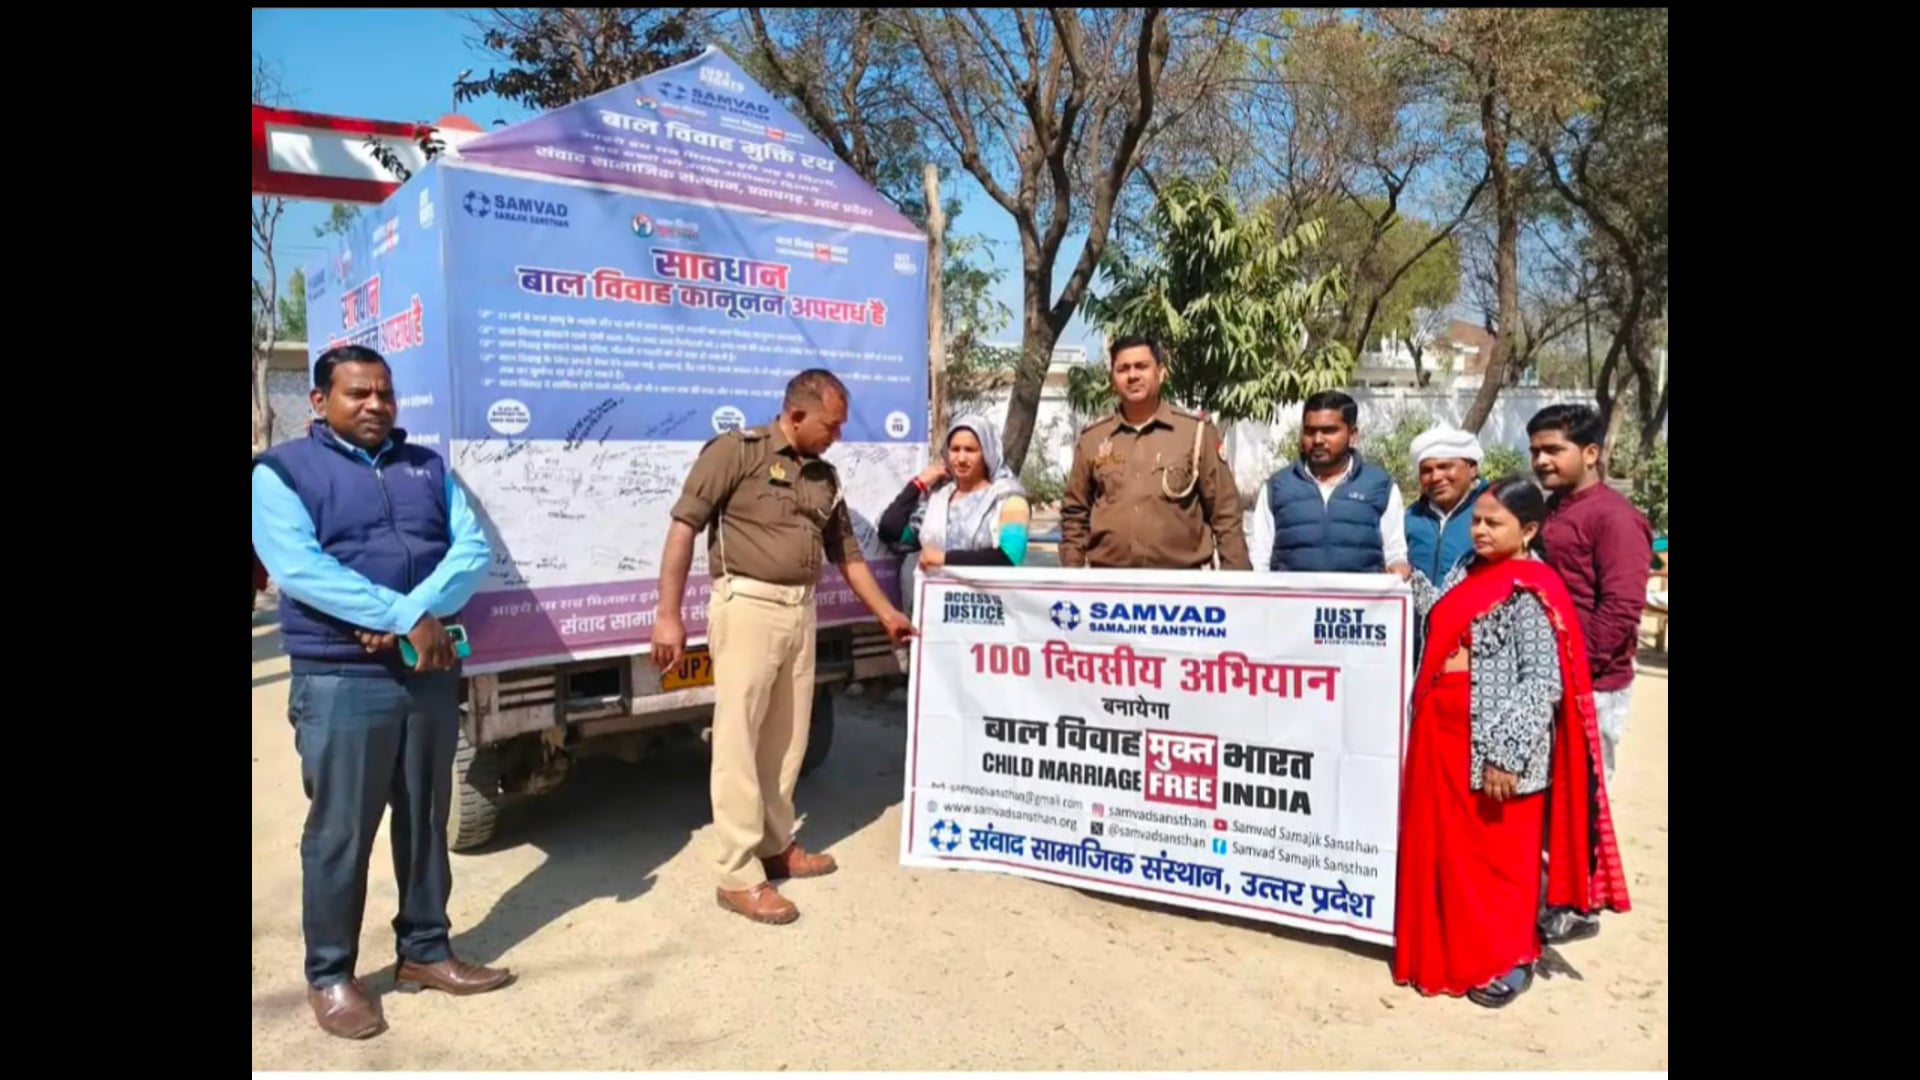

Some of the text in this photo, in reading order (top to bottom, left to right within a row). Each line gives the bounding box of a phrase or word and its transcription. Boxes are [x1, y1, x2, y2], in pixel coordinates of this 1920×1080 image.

[691, 87, 770, 115] SAMVAD
[601, 110, 657, 136] बाल
[666, 117, 734, 152] विवाह
[738, 139, 797, 164] मुक्ति
[801, 153, 836, 173] रथ
[494, 194, 568, 217] SAMVAD
[652, 248, 788, 291] सावधान
[517, 267, 887, 326] बाल विवाह कानूनन अपराध है
[560, 612, 606, 635] संवाद
[942, 604, 1005, 623] JUSTICE
[1090, 601, 1226, 624] SAMVAD
[1315, 607, 1365, 624] JUST
[1089, 622, 1227, 638] SAMAJIK SANSTHAN
[1314, 623, 1387, 641] RIGHTS
[971, 639, 1341, 701] 100 दिवसीय अभियान
[1102, 695, 1170, 720] बनायेगा
[983, 715, 1314, 780] बाल विवाह मुक्त भारत
[982, 752, 1312, 815] CHILD MARRIAGE FREE INDIA
[943, 803, 1078, 831] www.samvadsansthan.org
[1108, 805, 1207, 830] samvadsansthan
[1108, 822, 1206, 849] @samvadsansthan
[1232, 819, 1379, 856] Samvad Samajik Sansthan
[969, 822, 1375, 920] संवाद सामाजिक संस्थान, उत्तर प्रदेश
[1232, 842, 1378, 878] Samvad Samajik Sansthan
